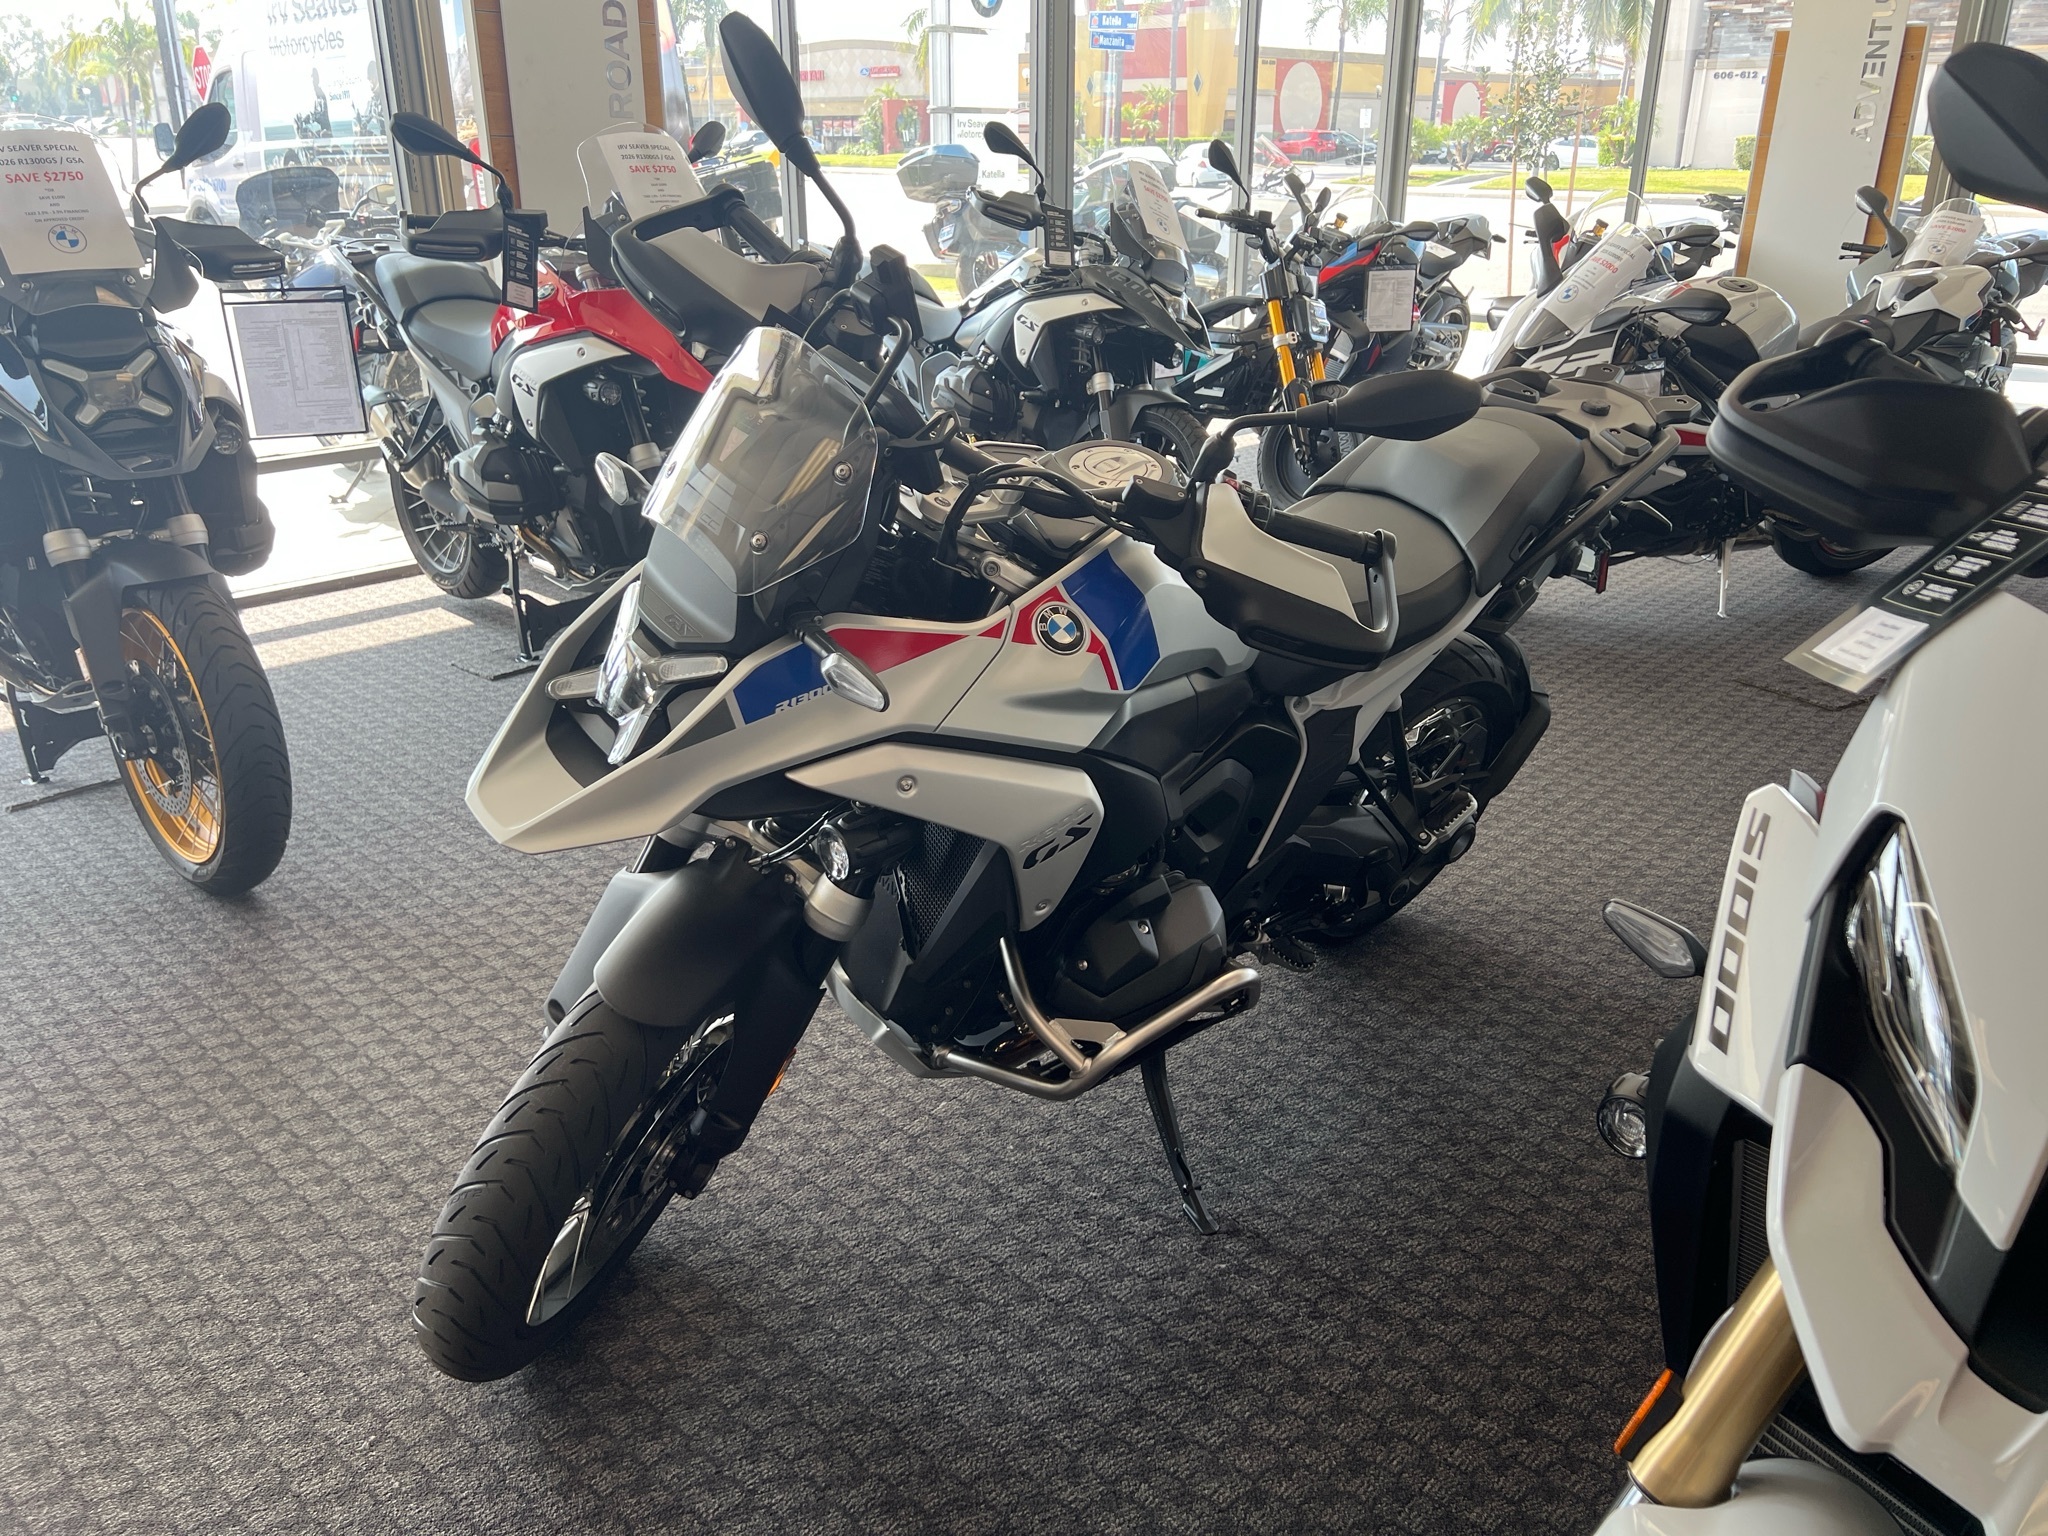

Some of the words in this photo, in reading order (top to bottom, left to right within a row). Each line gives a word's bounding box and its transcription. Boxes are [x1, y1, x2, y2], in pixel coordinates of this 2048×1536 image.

[293, 0, 358, 25] Seaver
[1102, 15, 1122, 26] Katella
[268, 27, 345, 58] Motorcycles
[1099, 35, 1125, 47] Manzanita
[602, 0, 634, 119] ROAD
[194, 64, 212, 88] STOP
[1713, 70, 1759, 79] 606-612
[7, 144, 42, 153] SEAVER
[44, 144, 79, 152] SPECIAL
[18, 157, 58, 165] R1300GS
[629, 165, 651, 173] SAVE
[652, 165, 677, 174] $2750
[981, 170, 1005, 178] Katella
[5, 172, 41, 184] SAVE
[43, 171, 84, 183] $2750
[1022, 811, 1095, 870] GS
